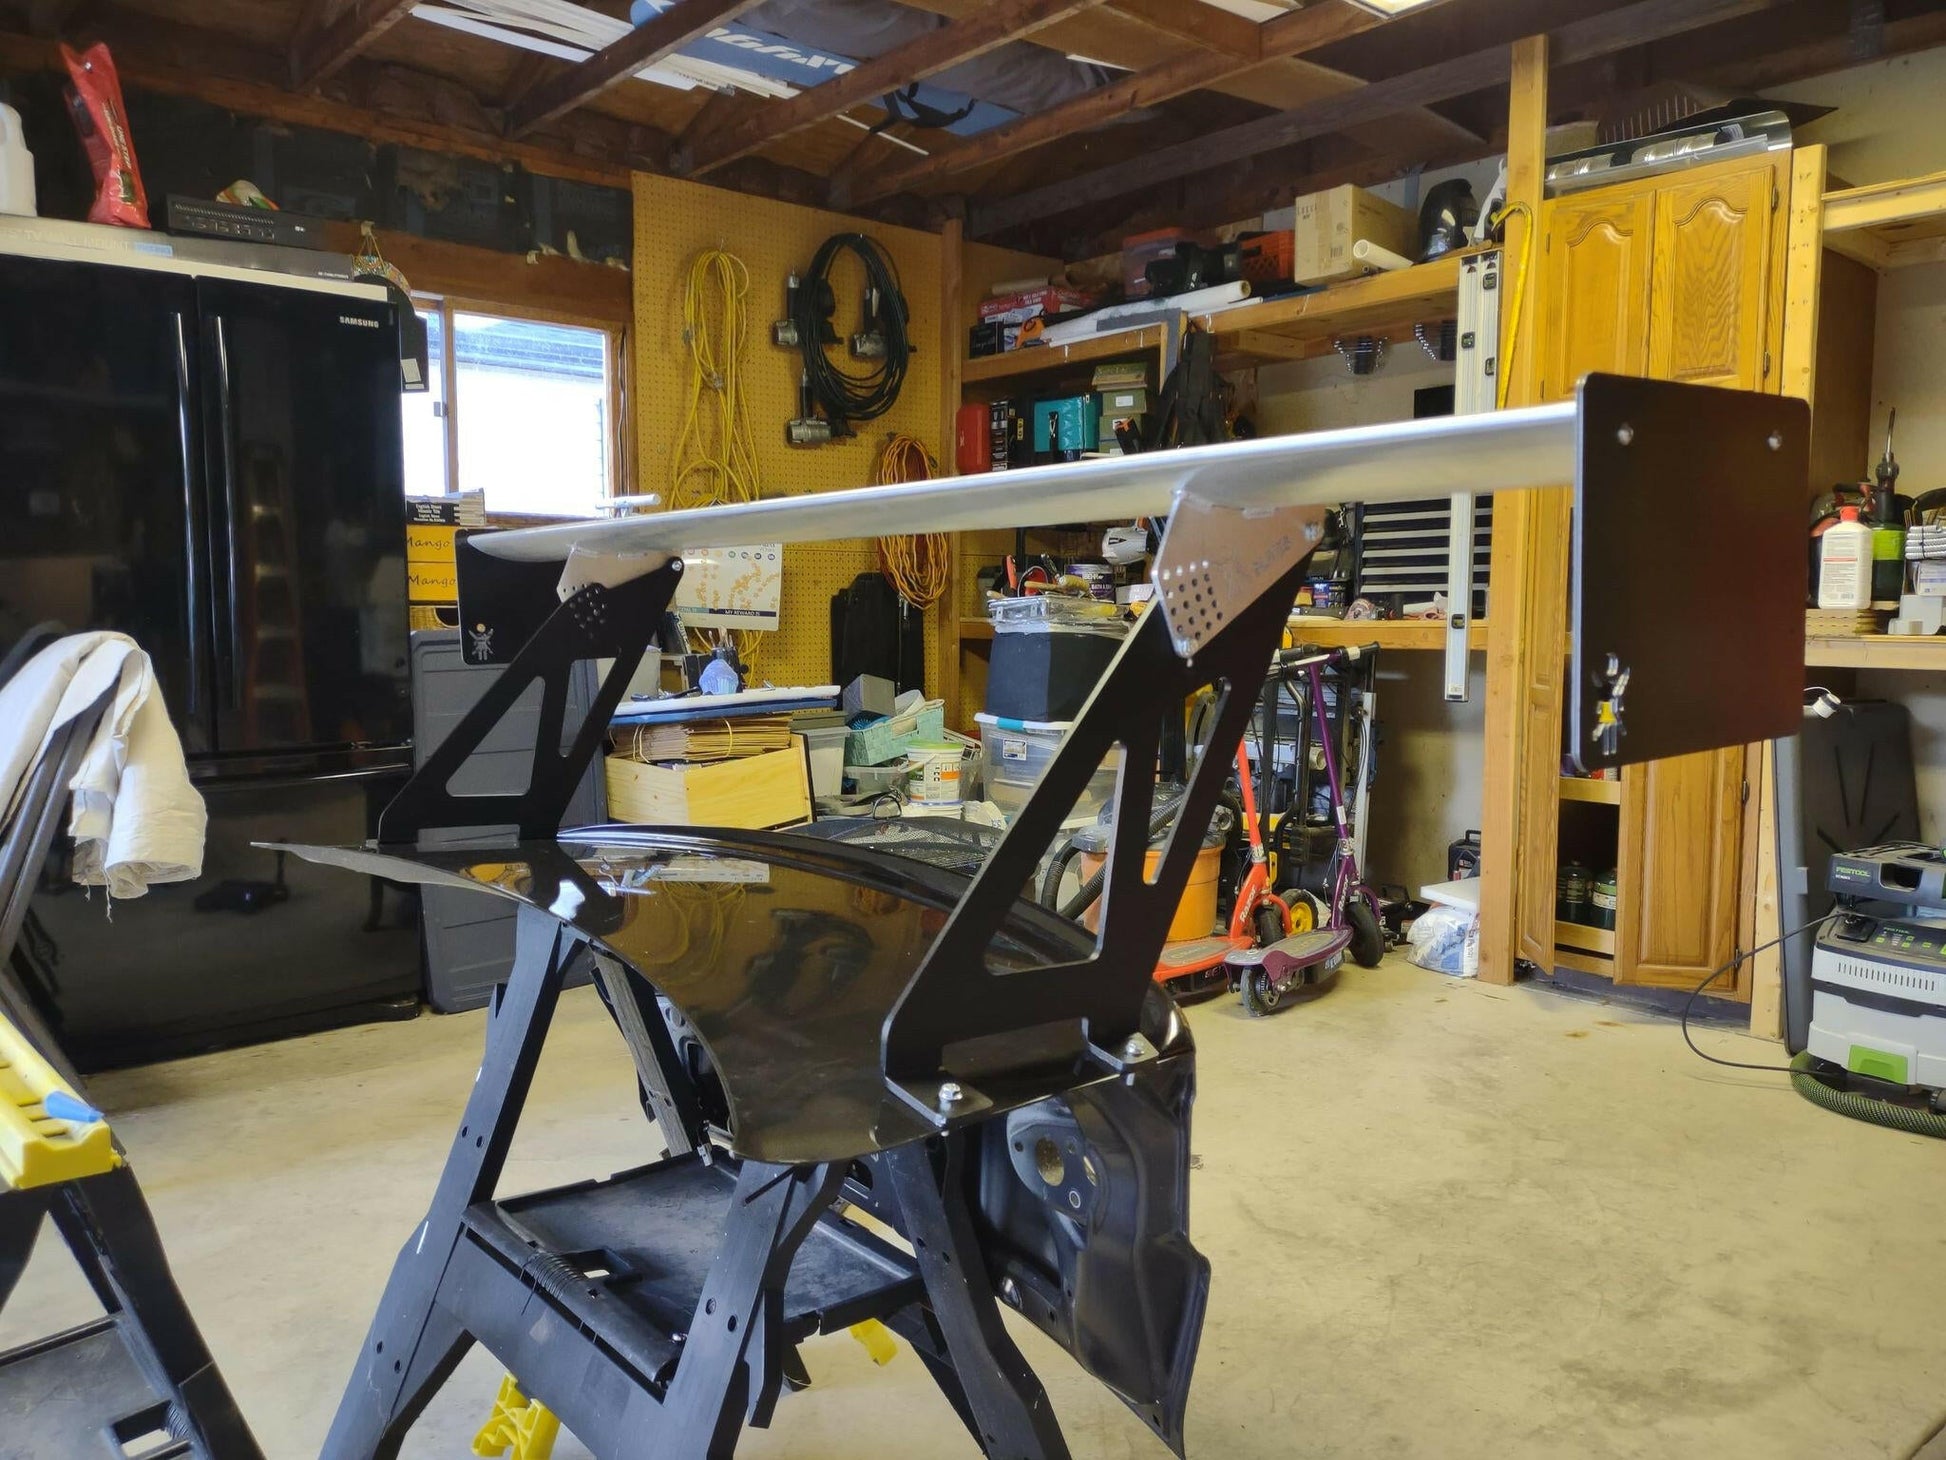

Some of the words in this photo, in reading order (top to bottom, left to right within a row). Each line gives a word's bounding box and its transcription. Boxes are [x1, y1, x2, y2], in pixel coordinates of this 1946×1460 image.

[339, 316, 379, 328] SAMSUNG
[408, 575, 456, 588] Mango
[1836, 866, 1871, 878] FESTOOL
[1338, 874, 1348, 911] Razor
[1240, 884, 1257, 922] Razor
